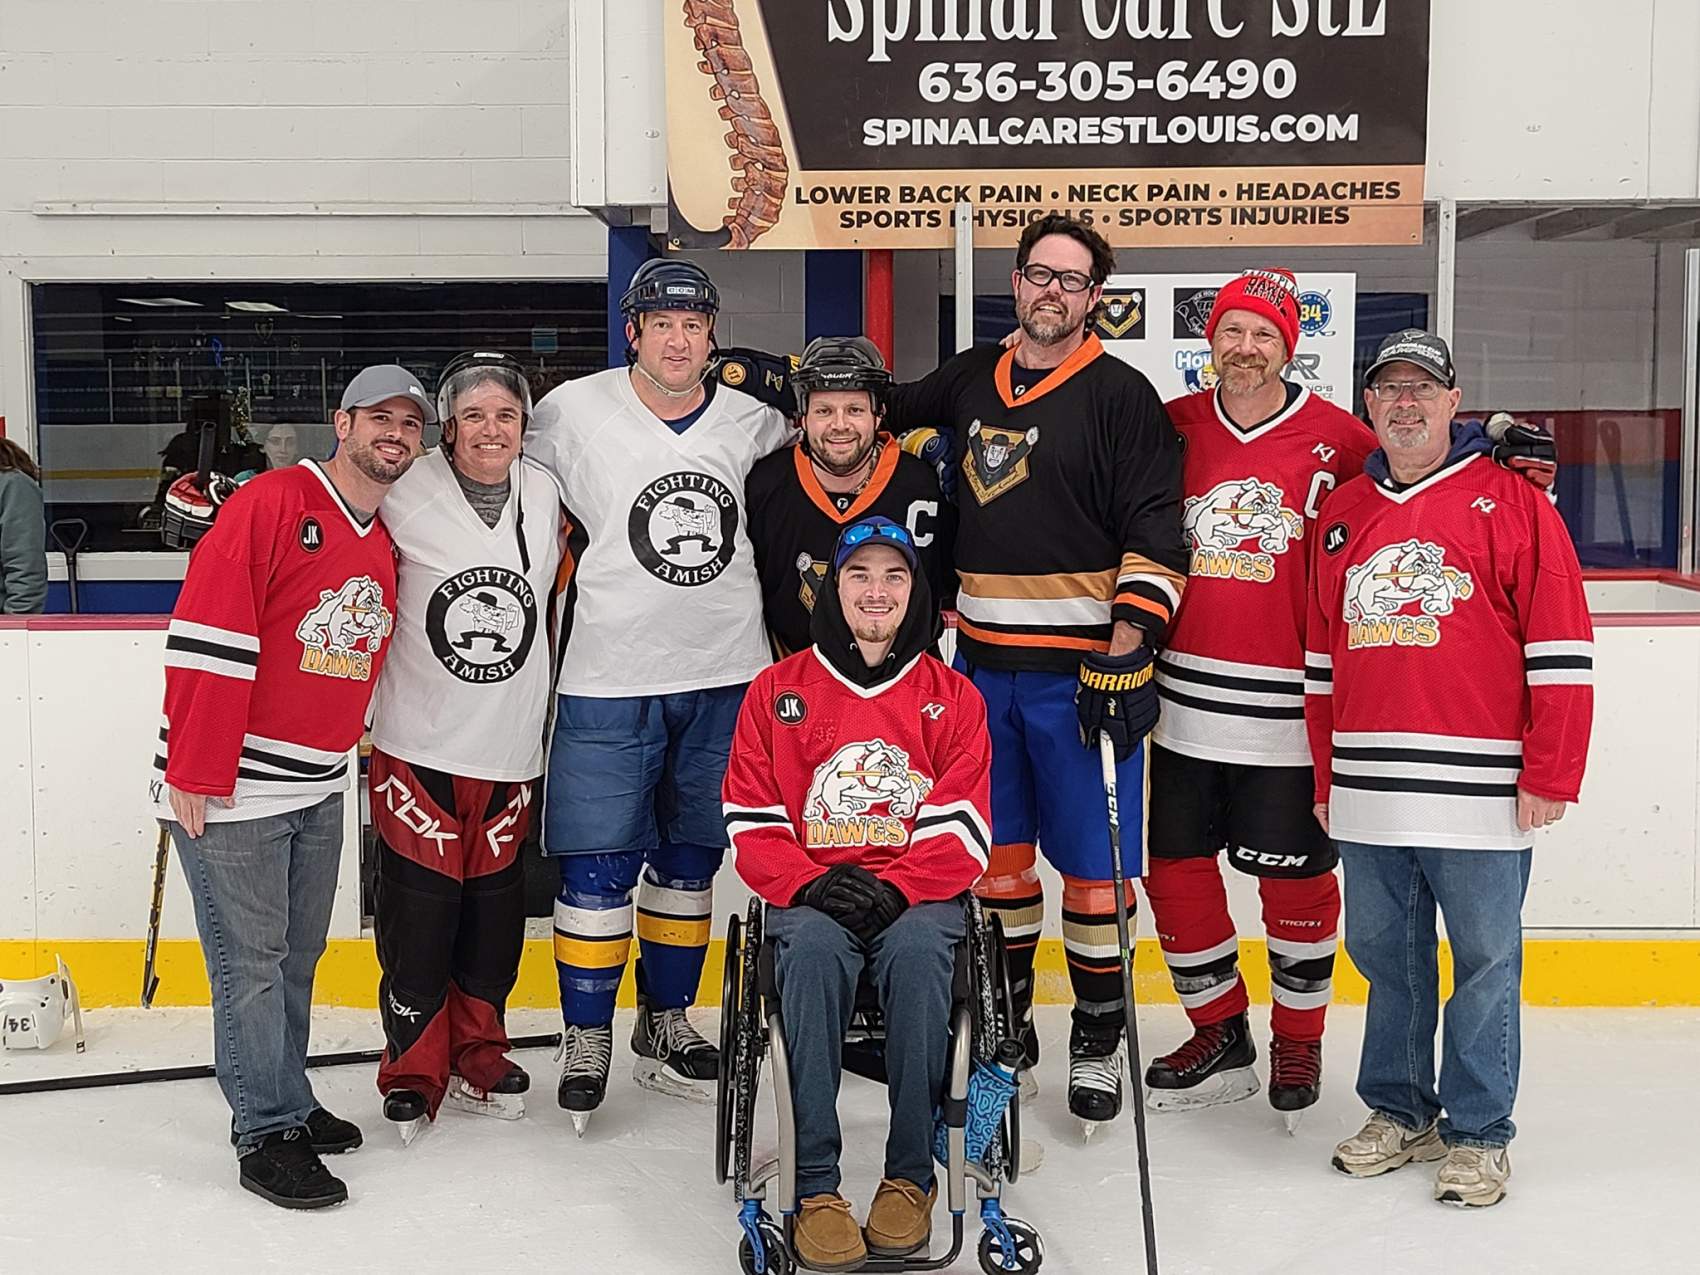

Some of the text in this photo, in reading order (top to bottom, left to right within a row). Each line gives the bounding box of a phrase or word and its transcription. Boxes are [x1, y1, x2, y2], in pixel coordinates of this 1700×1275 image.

[918, 58, 1297, 103] 636-305-6490
[863, 113, 1359, 146] SPINALCARESTLOUIS.COM
[795, 181, 1401, 205] LOWER BACK PAIN NECK PAIN HEADACHES
[839, 210, 942, 229] SPORTS
[1118, 208, 1222, 226] SPORTS
[1230, 207, 1350, 226] INJURIES
[636, 475, 733, 511] FIGHTING
[1304, 470, 1336, 519] C
[303, 525, 319, 544] JK
[906, 500, 938, 547] C
[1327, 527, 1344, 550] JK
[654, 558, 724, 583] AMISH
[1189, 549, 1276, 583] AWGS
[438, 569, 534, 608] FIGHTING
[301, 645, 371, 681] DAWGS
[444, 654, 515, 681] AMISH
[780, 698, 801, 718] JK
[806, 817, 906, 848] DAWGS
[1236, 846, 1308, 867] CCM
[8, 1017, 30, 1033] 34
